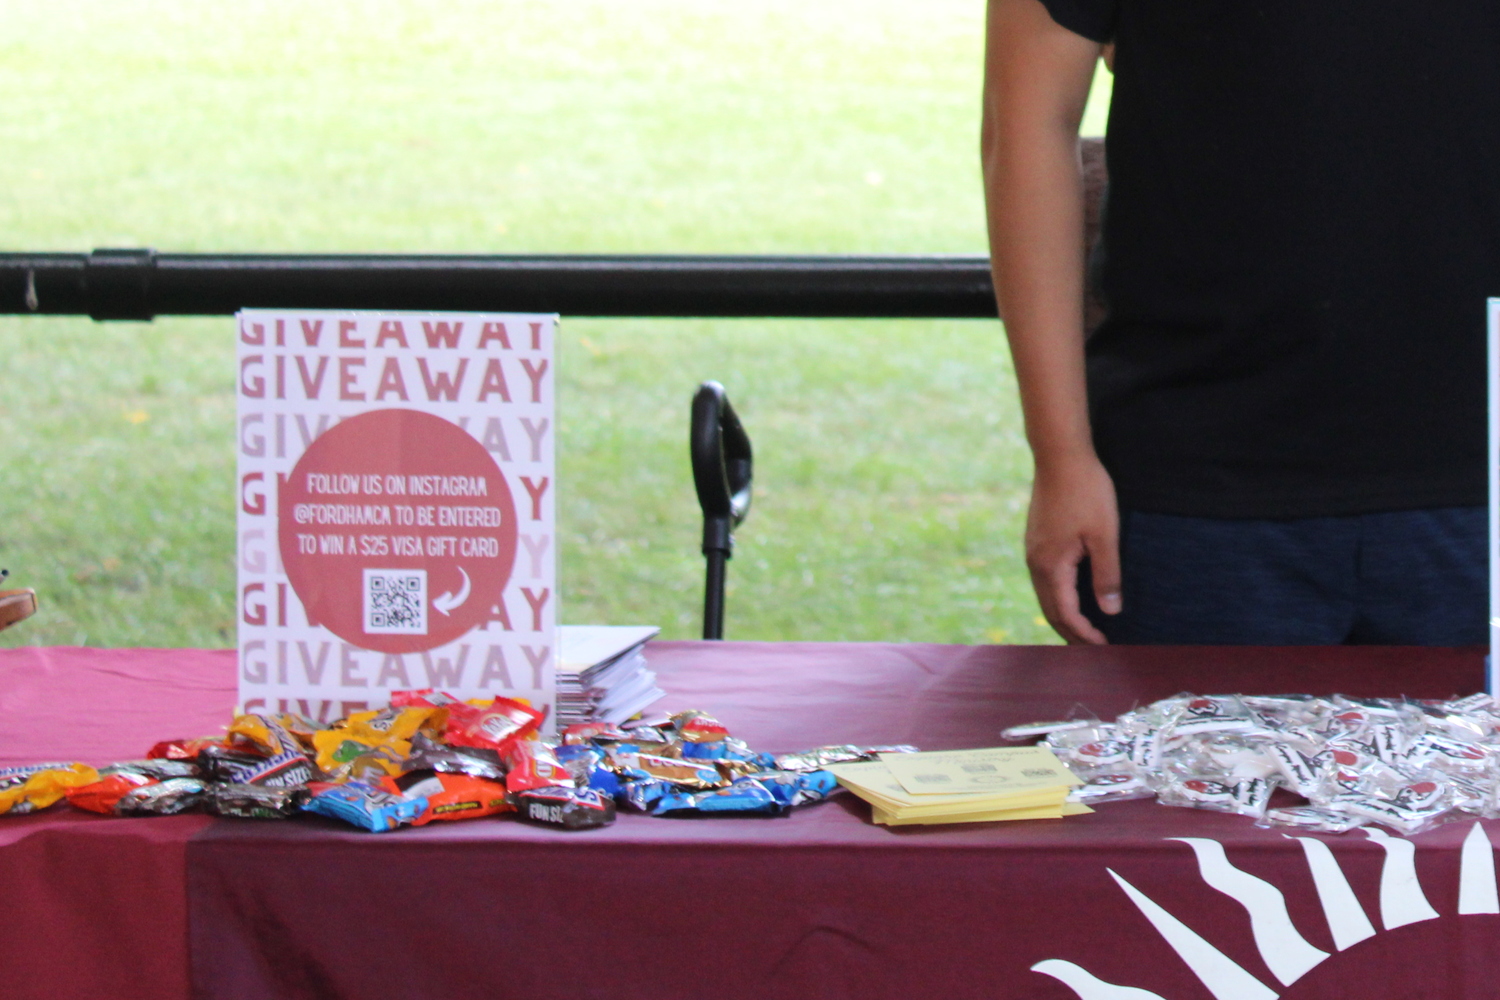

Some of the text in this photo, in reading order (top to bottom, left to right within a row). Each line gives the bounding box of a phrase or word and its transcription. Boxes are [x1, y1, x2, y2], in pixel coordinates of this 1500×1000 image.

[240, 353, 549, 404] GIVEAWAY
[306, 473, 360, 495] FOLLOW
[362, 474, 383, 495] US
[385, 474, 406, 496] ON
[408, 475, 487, 497] INSTAGRAM
[293, 503, 502, 528] @FORDHAMCM TO BE ENTERED
[297, 533, 317, 555] TO
[319, 534, 344, 555] WIN
[347, 534, 357, 555] A
[360, 534, 389, 556] $25
[391, 535, 424, 557] VISA
[426, 536, 458, 558] GIFT
[460, 536, 499, 558] CARD
[243, 639, 551, 690] GIVEAWAY
[529, 803, 549, 821] FUN
